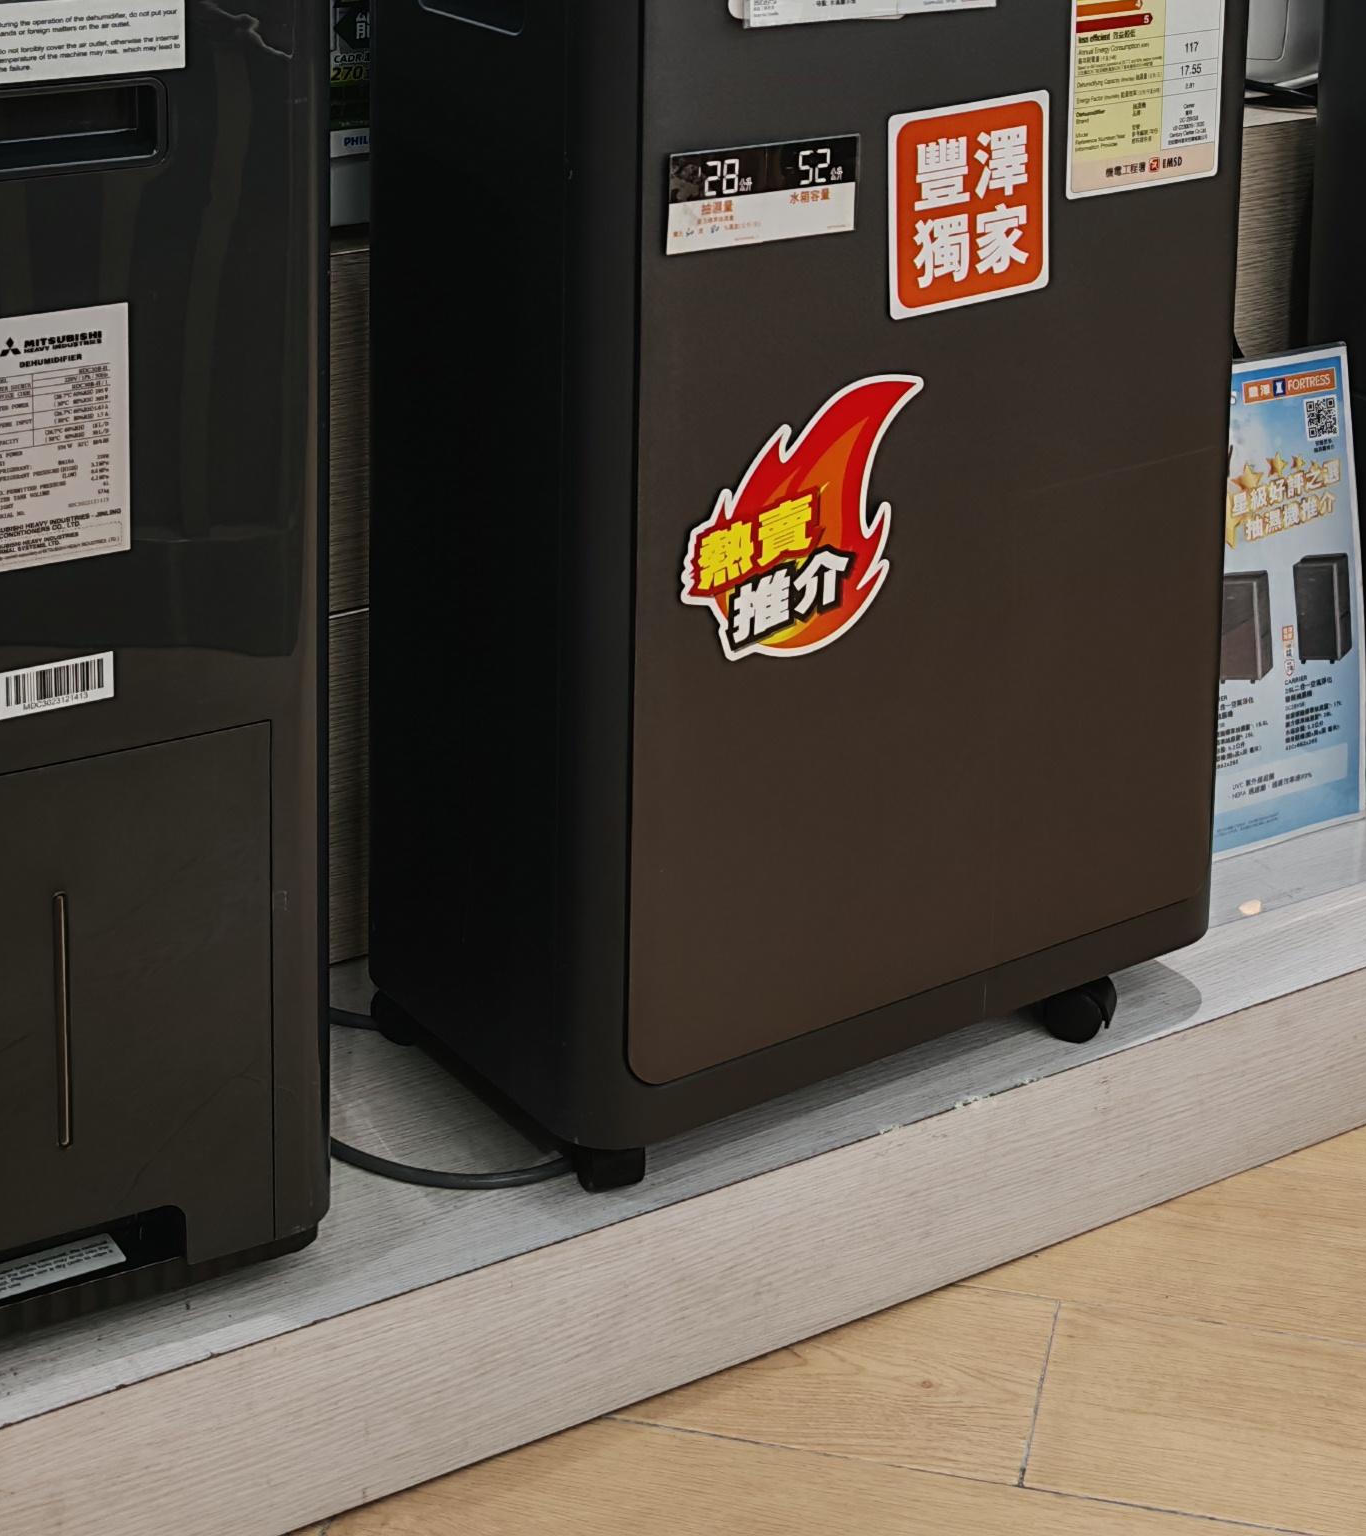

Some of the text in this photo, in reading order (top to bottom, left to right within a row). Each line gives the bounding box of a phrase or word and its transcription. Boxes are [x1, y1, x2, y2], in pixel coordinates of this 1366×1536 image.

[1089, 34, 1111, 42] efficient
[1094, 43, 1141, 54] Energy Consumption
[1185, 41, 1199, 53] 117
[331, 66, 363, 82] 270
[1180, 63, 1202, 75] 17.55
[915, 124, 1028, 211] 豐澤
[1105, 156, 1183, 177] 機電工程署 EMSD
[704, 159, 740, 197] 28
[789, 188, 830, 205] 水箱容量
[701, 200, 733, 215] 抽濕量
[913, 201, 1029, 288] 獨家
[24, 330, 102, 348] MITSUBISHI
[52, 339, 102, 349] INDUSTRIES
[19, 354, 82, 368] DEHUMIDIFIER
[1287, 374, 1331, 391] FORTRESS
[1233, 459, 1340, 514] 星級好評之選
[1245, 493, 1336, 541] 抽濕機推介
[696, 495, 814, 590] 熱賣
[732, 549, 848, 643] 推介
[1285, 675, 1307, 685] CARRIER
